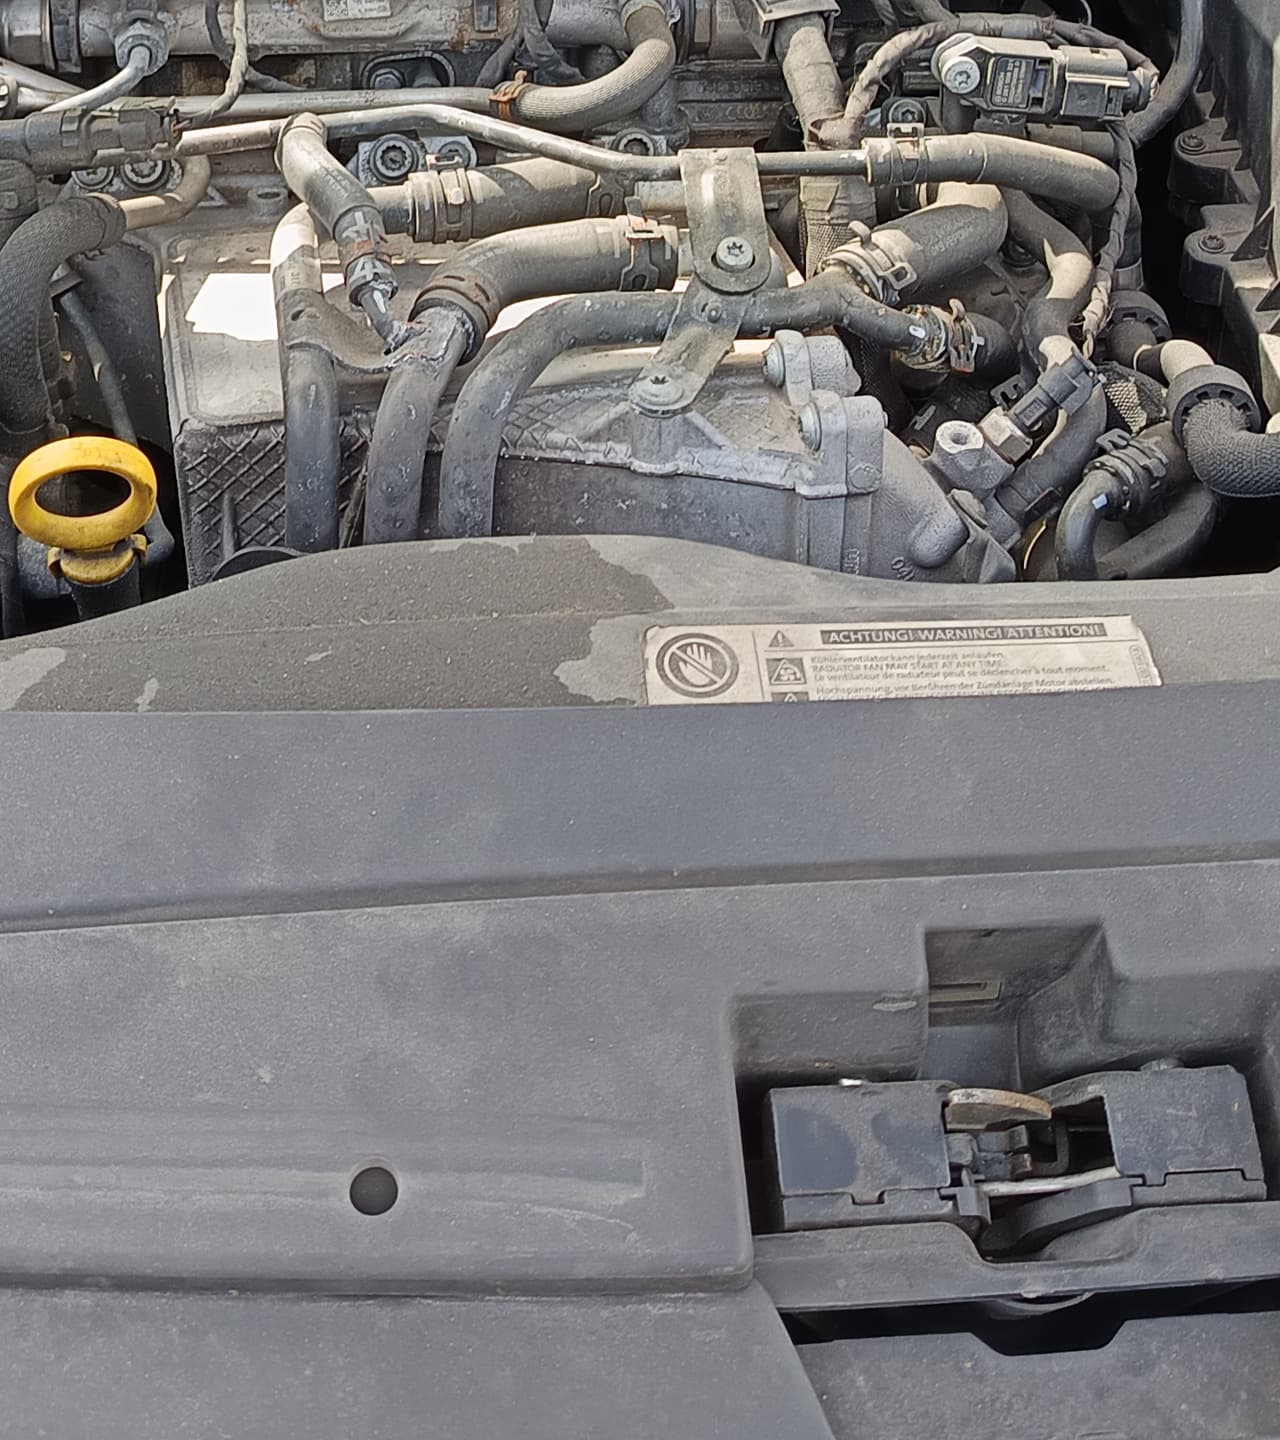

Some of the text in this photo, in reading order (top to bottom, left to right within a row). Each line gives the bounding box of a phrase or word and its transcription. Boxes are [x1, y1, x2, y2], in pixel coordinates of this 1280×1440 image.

[829, 624, 1100, 644] ACHTUNG! WARNING! ATTENTION!
